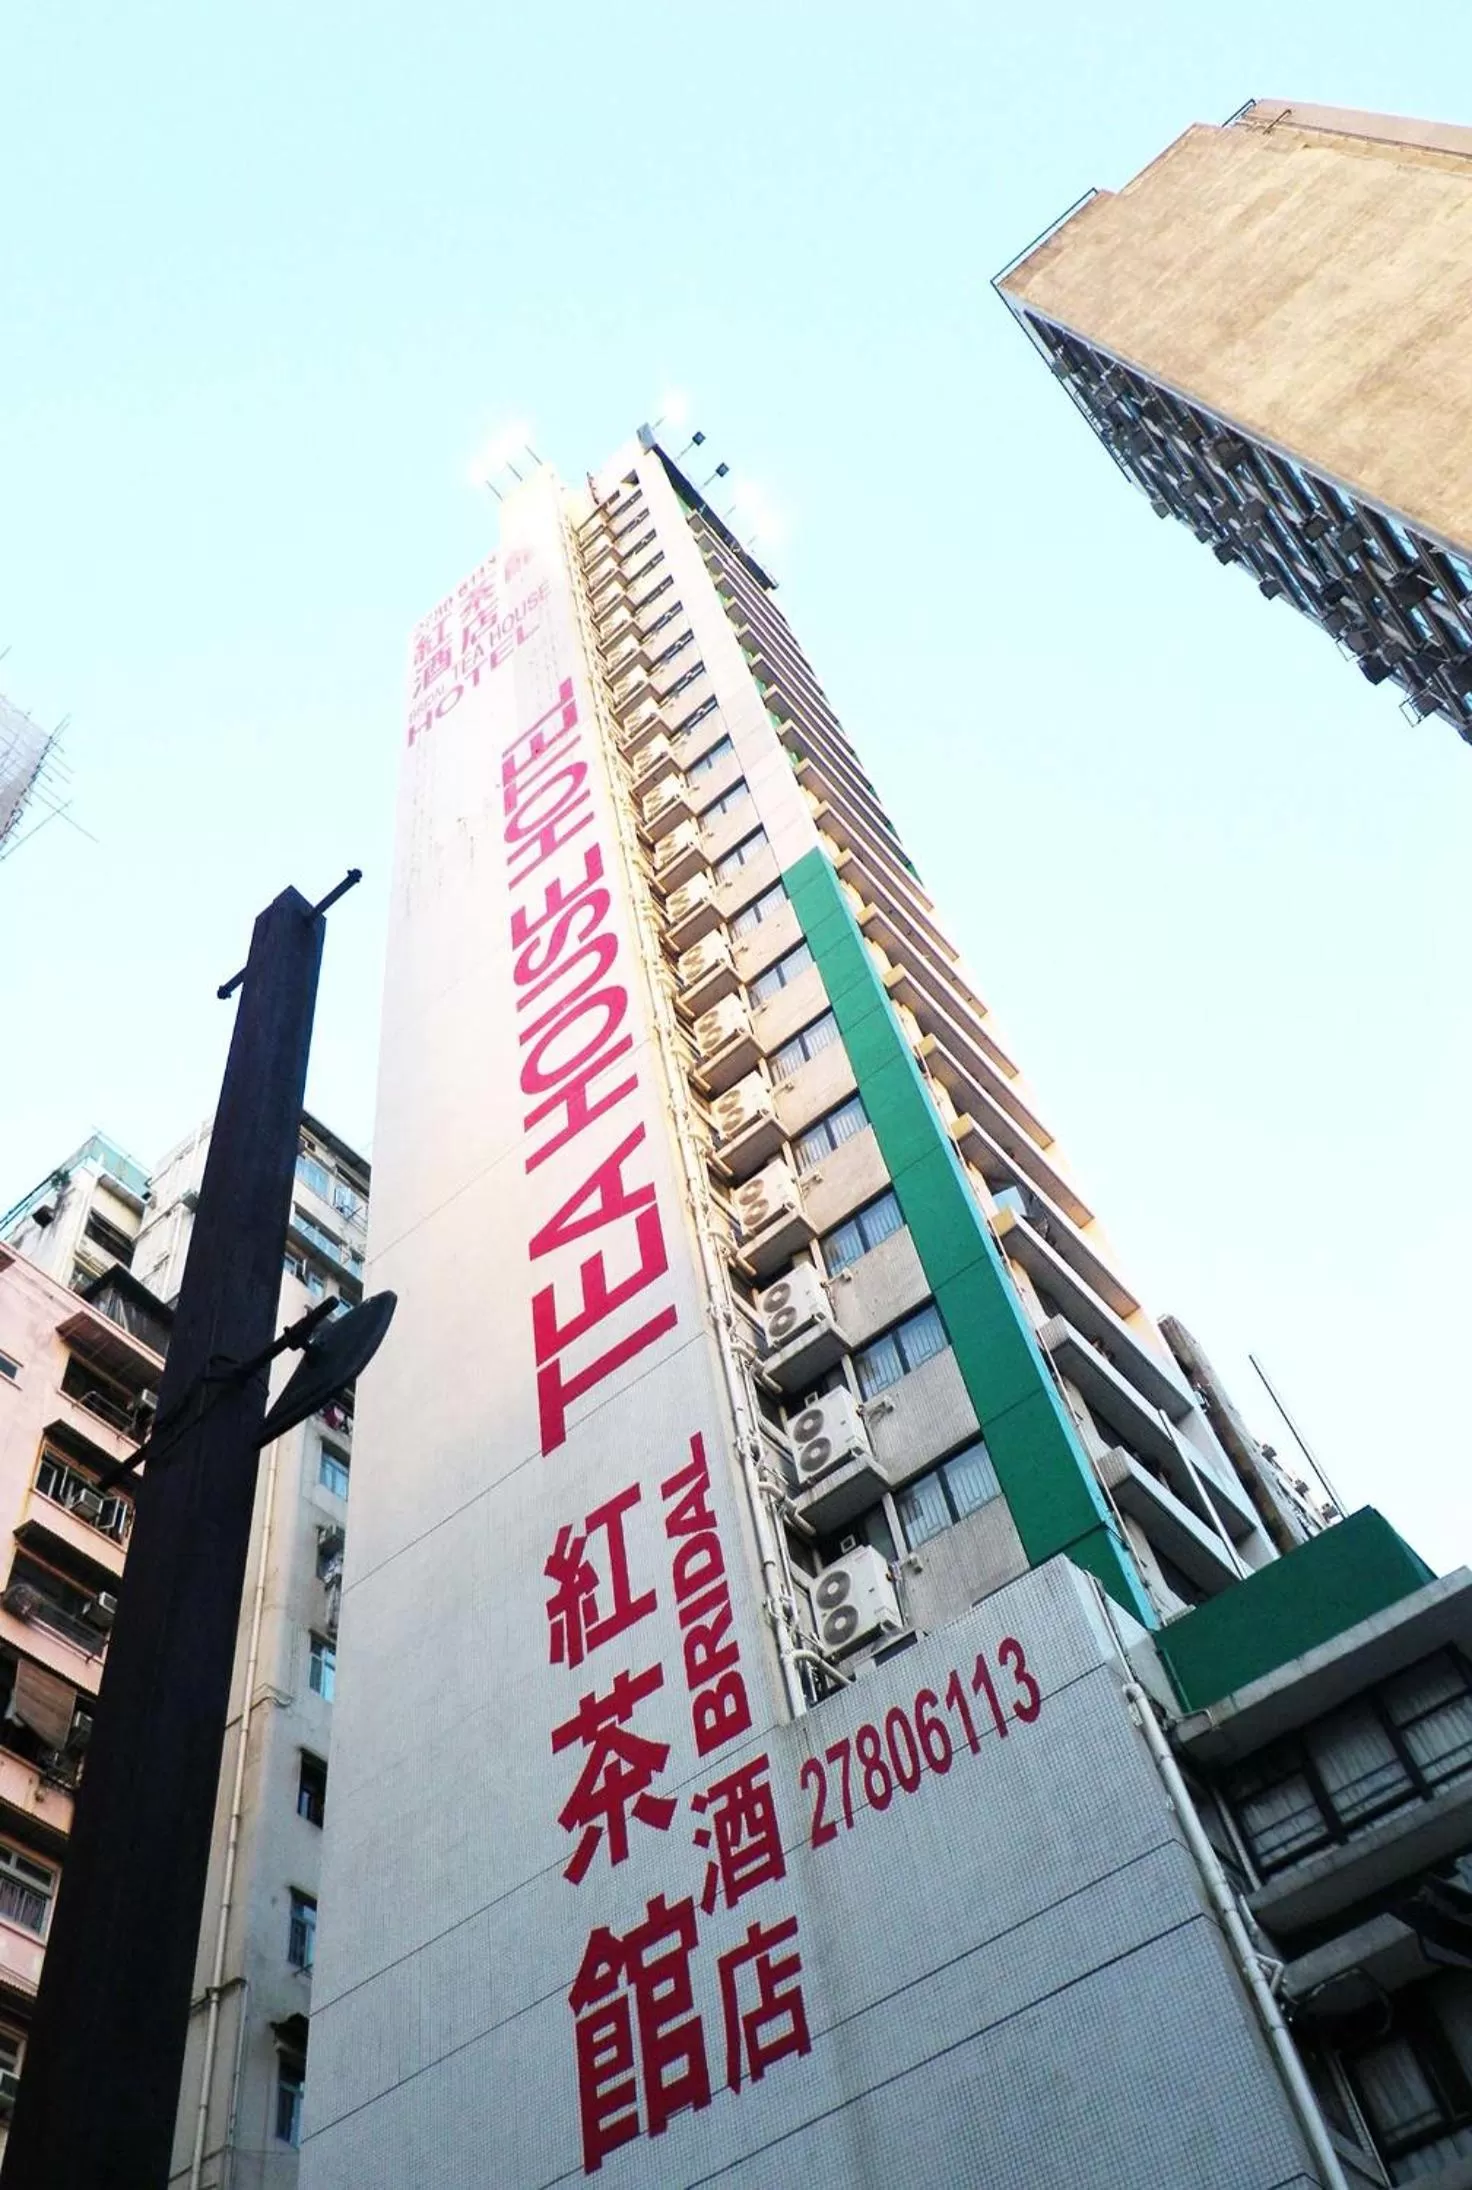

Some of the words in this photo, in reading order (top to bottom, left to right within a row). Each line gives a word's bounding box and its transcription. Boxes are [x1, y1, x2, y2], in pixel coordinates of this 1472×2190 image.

[408, 624, 540, 748] HOTEL
[413, 597, 499, 700] 酒店
[451, 643, 486, 681] TEA
[489, 580, 550, 647] HOUSE
[501, 675, 595, 891] HOTEL
[510, 841, 640, 1175] HOUSE
[527, 1121, 679, 1458] TEA
[660, 1431, 753, 1758] BRIDAL
[543, 1483, 712, 2175] 紅茶館
[800, 1637, 1042, 1850] 27806113
[690, 1753, 812, 2095] 酒店
